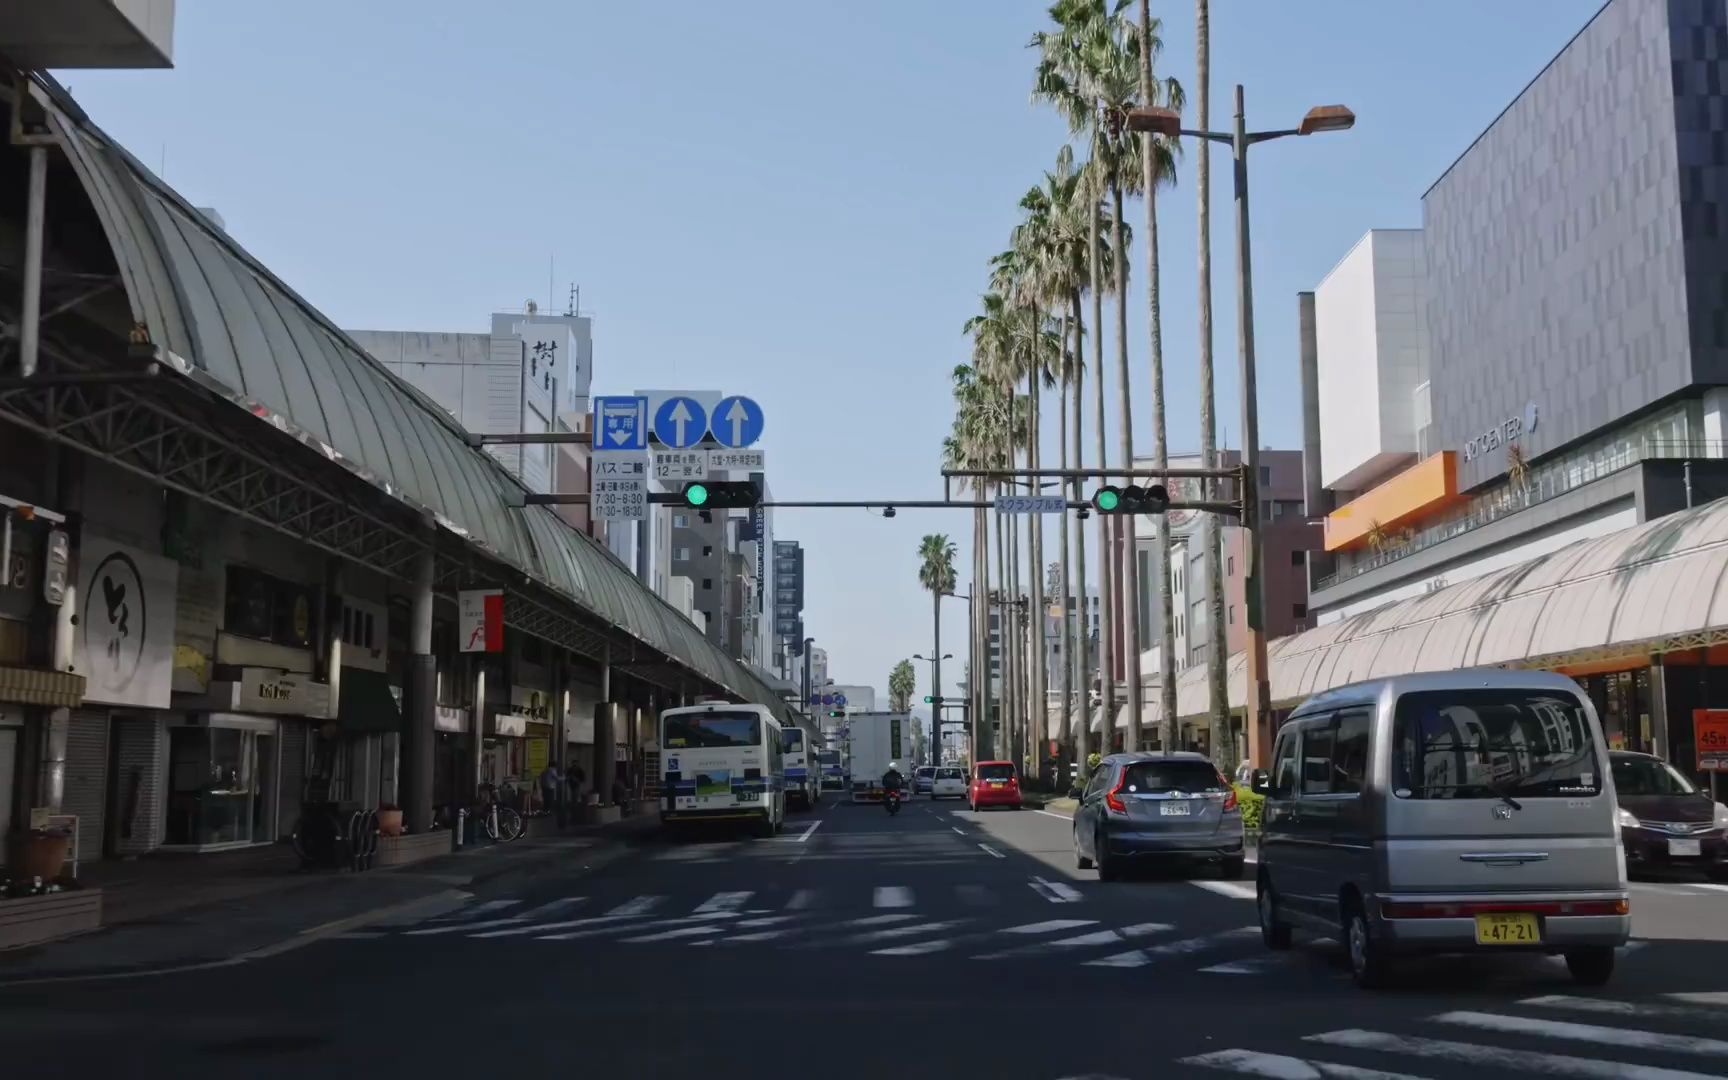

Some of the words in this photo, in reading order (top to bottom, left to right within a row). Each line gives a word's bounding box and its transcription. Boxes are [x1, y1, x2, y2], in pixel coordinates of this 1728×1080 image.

[608, 417, 633, 429] 専用
[596, 462, 617, 474] バス
[621, 462, 643, 474] 二輪
[755, 508, 763, 534] GREEN
